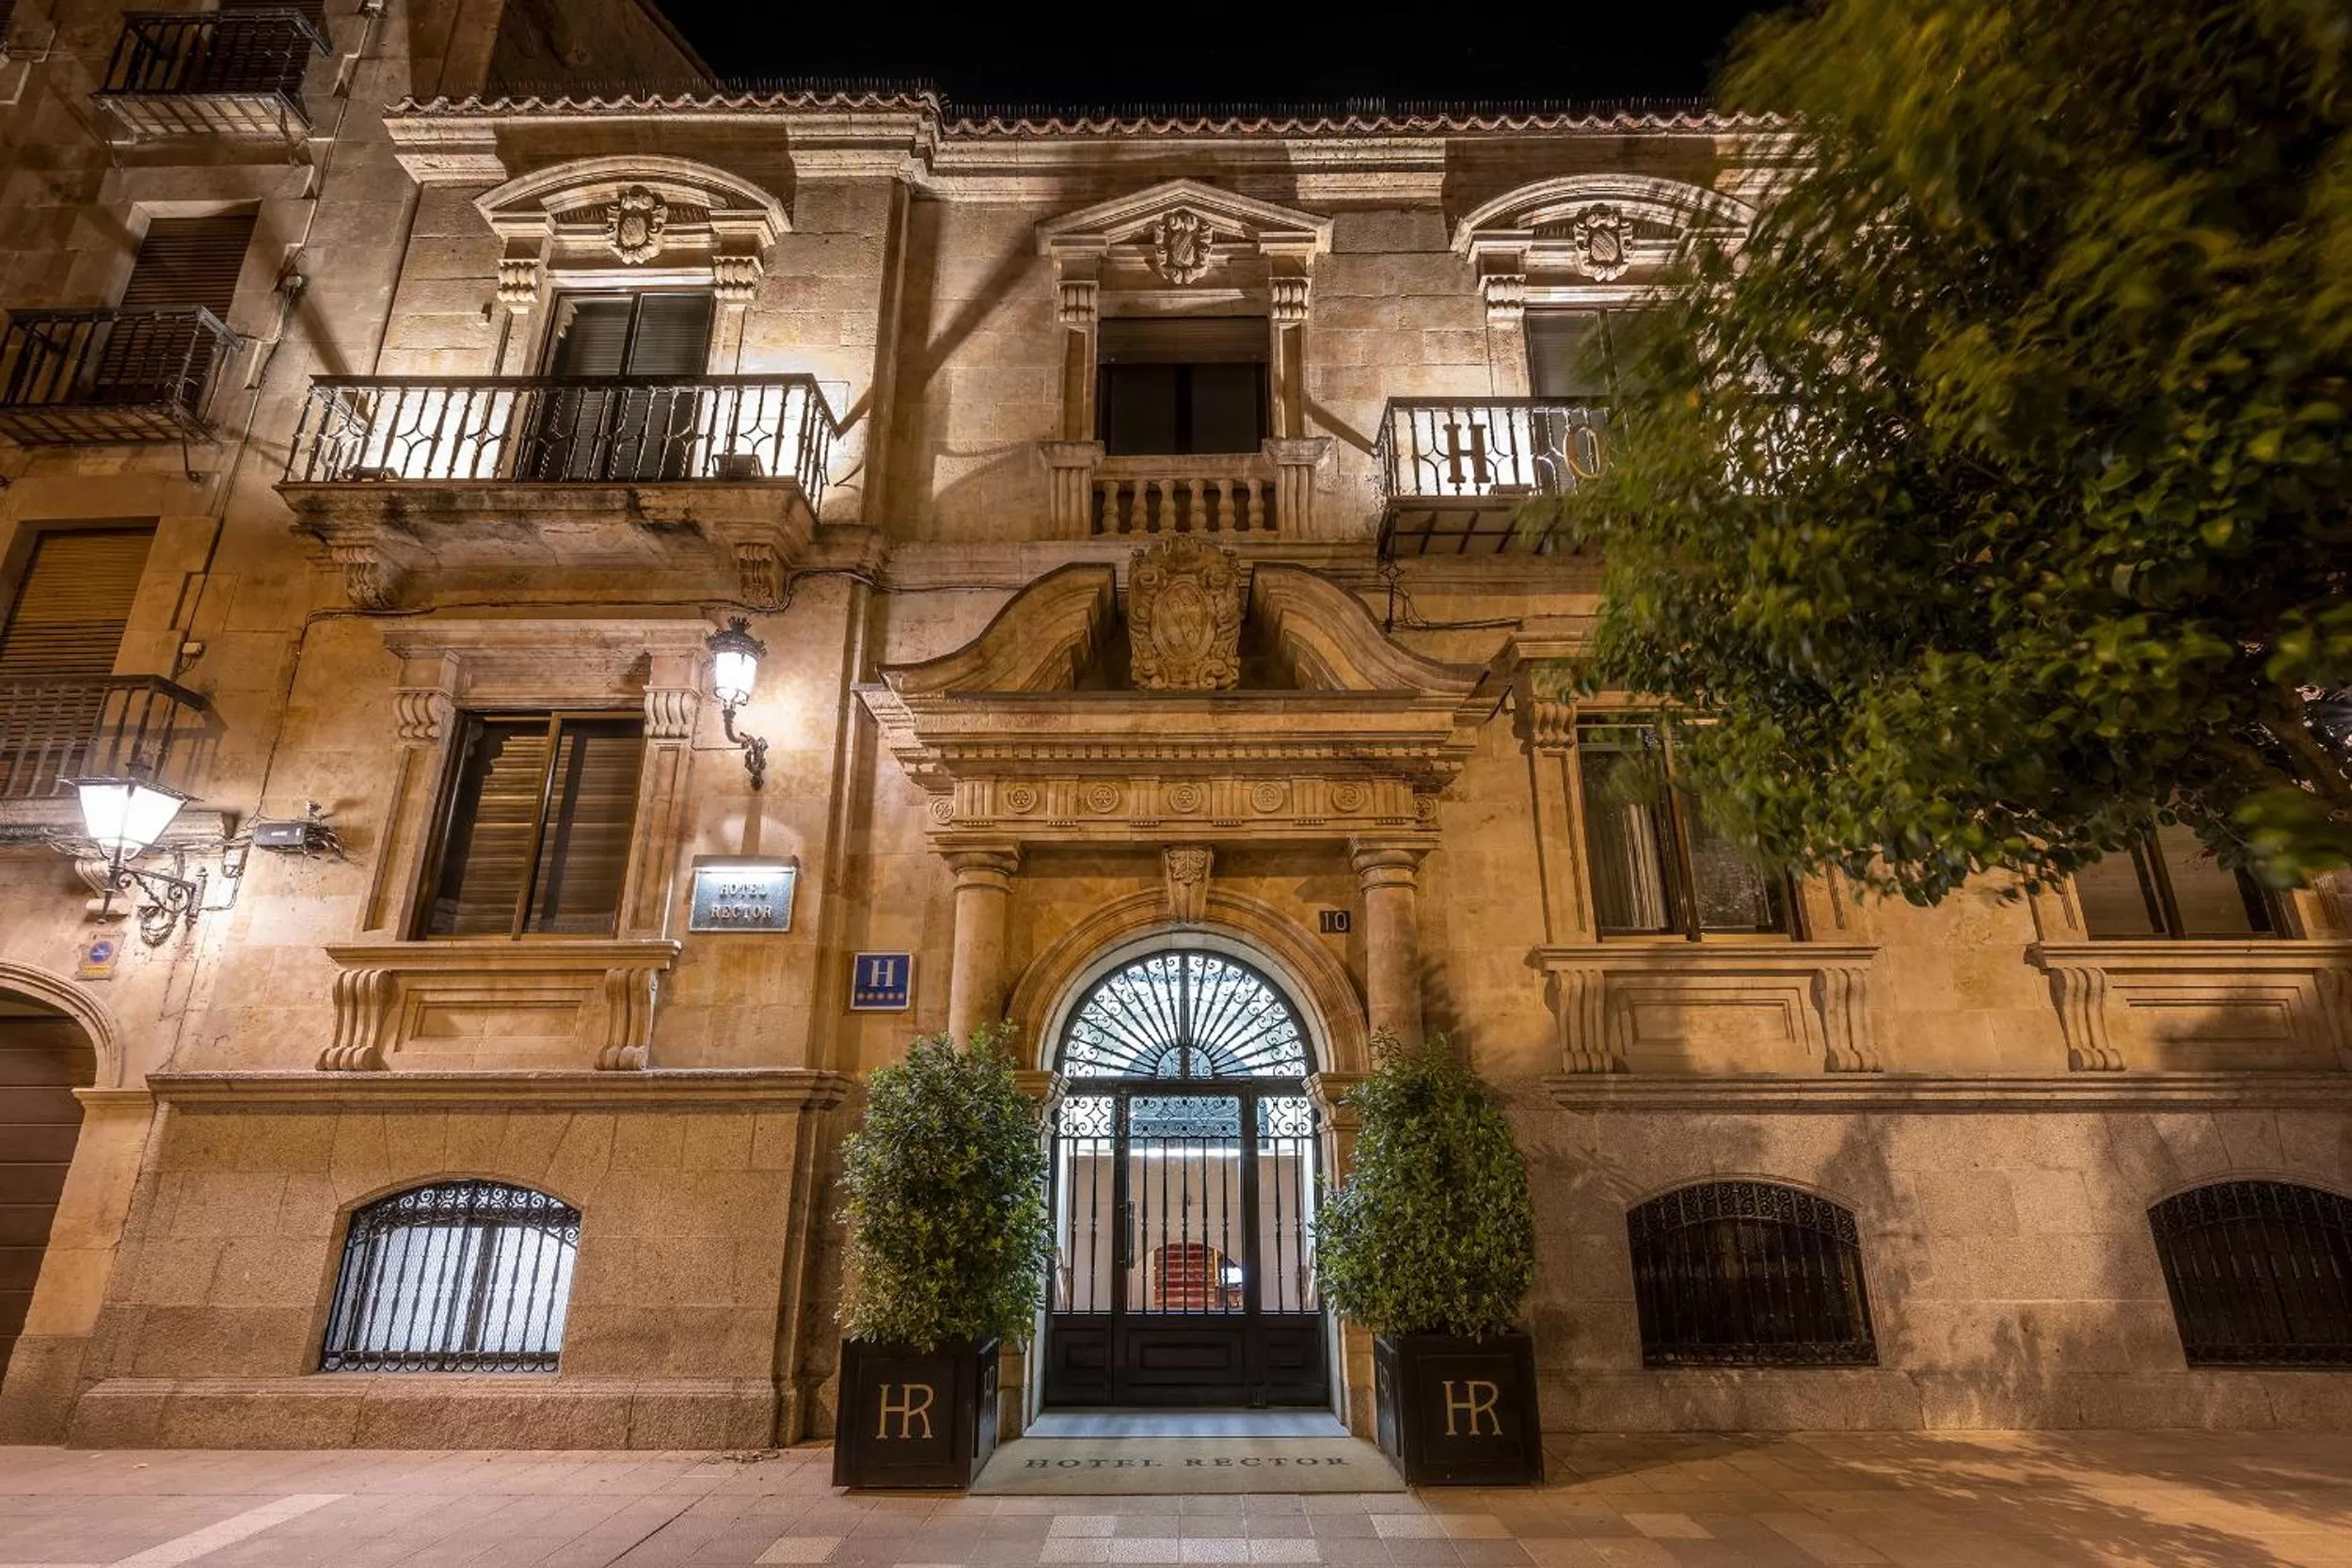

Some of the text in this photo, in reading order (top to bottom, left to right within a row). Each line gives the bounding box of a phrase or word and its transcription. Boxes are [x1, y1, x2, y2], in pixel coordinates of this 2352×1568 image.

[709, 904, 772, 919] RECTOR
[1324, 911, 1347, 932] 10
[867, 958, 897, 988] H
[875, 1384, 933, 1439] HR
[1442, 1380, 1503, 1436] HR
[1025, 1457, 1350, 1468] HOTEL RECTOR
